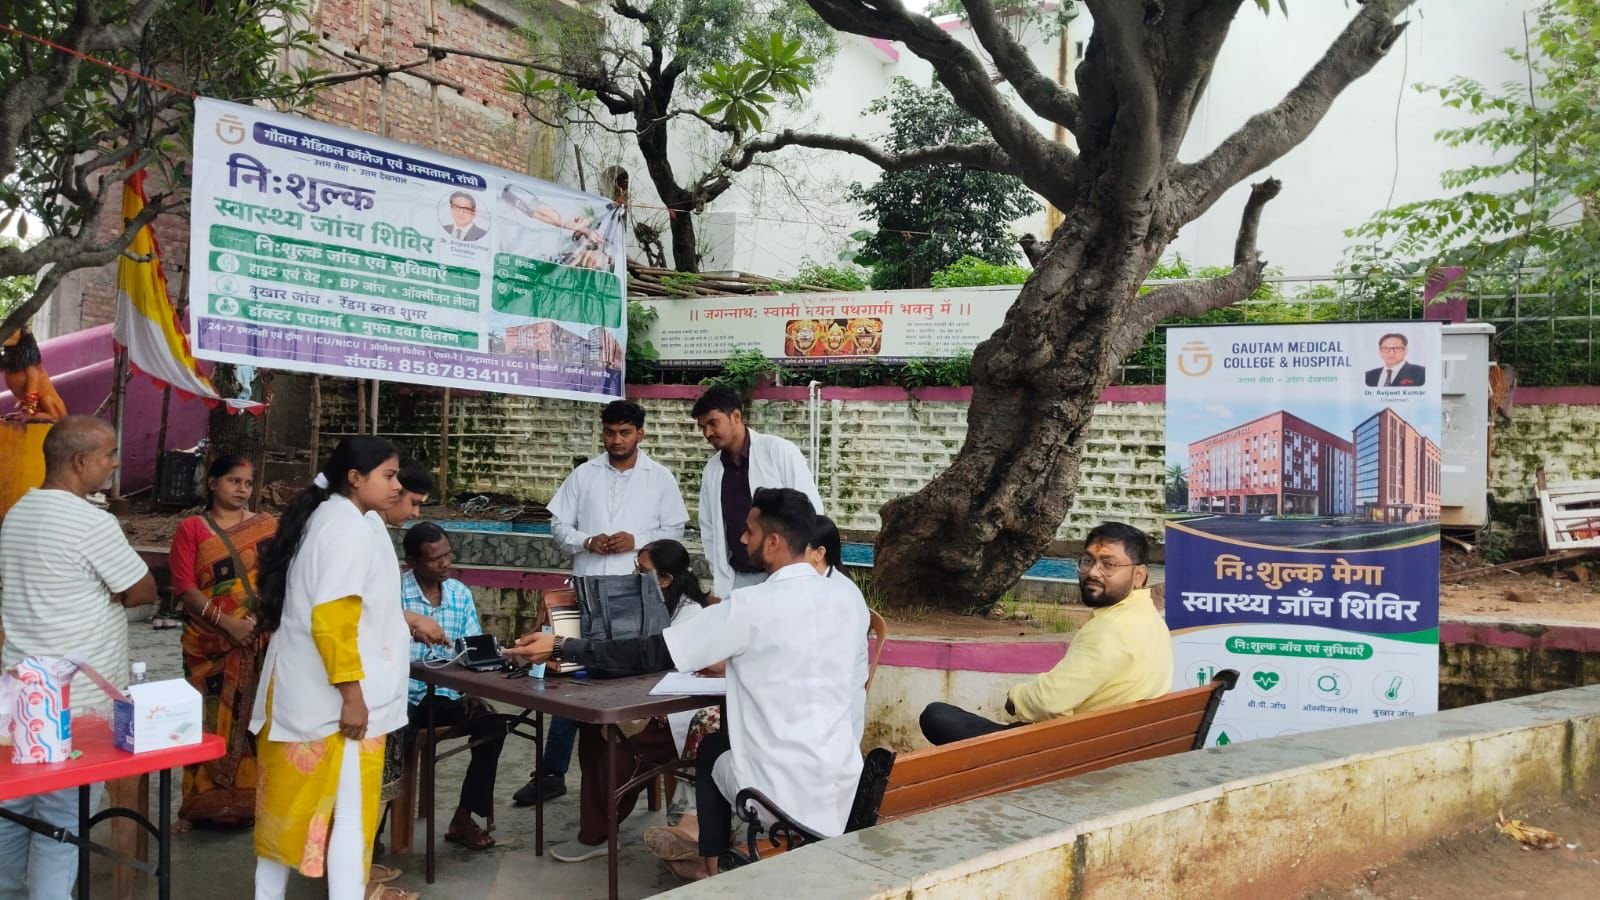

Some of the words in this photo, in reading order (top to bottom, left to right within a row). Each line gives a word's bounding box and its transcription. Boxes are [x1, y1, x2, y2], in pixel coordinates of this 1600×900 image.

[264, 127, 297, 147] गौतम
[301, 135, 344, 157] मेडिकल
[347, 145, 384, 166] कॉलेज
[387, 157, 403, 172] एवं
[214, 197, 305, 231] स्वास्थ्य
[310, 214, 365, 241] जांच
[371, 222, 435, 254] शिविर
[326, 248, 361, 266] जांच
[365, 255, 387, 271] एवं
[249, 262, 277, 278] हाइट
[340, 279, 359, 290] BP
[401, 287, 449, 306] ऑक्सीजन
[249, 285, 286, 300] बुखार
[400, 304, 428, 320] शुगर
[763, 303, 801, 318] स्वामी
[805, 305, 835, 316] नयन
[841, 301, 894, 316] पथगामी
[900, 303, 934, 320] भवतु
[248, 304, 291, 322] डॉक्टर
[296, 311, 344, 329] परामर्श
[314, 335, 360, 349] ICU/NICU
[1232, 342, 1283, 354] GAUTAM
[1288, 341, 1343, 353] MEDICAL
[398, 359, 520, 385] 8587834111
[1224, 357, 1276, 369] COLLEGE
[1280, 357, 1288, 368] &
[1293, 356, 1352, 368] HOSPITAL
[1331, 558, 1385, 585] मेगा
[1181, 591, 1272, 615] स्वास्थ्य
[1277, 588, 1334, 618] जाँच
[1339, 590, 1421, 622] शिविर
[1280, 640, 1301, 653] जाँच
[1304, 643, 1320, 654] एवं
